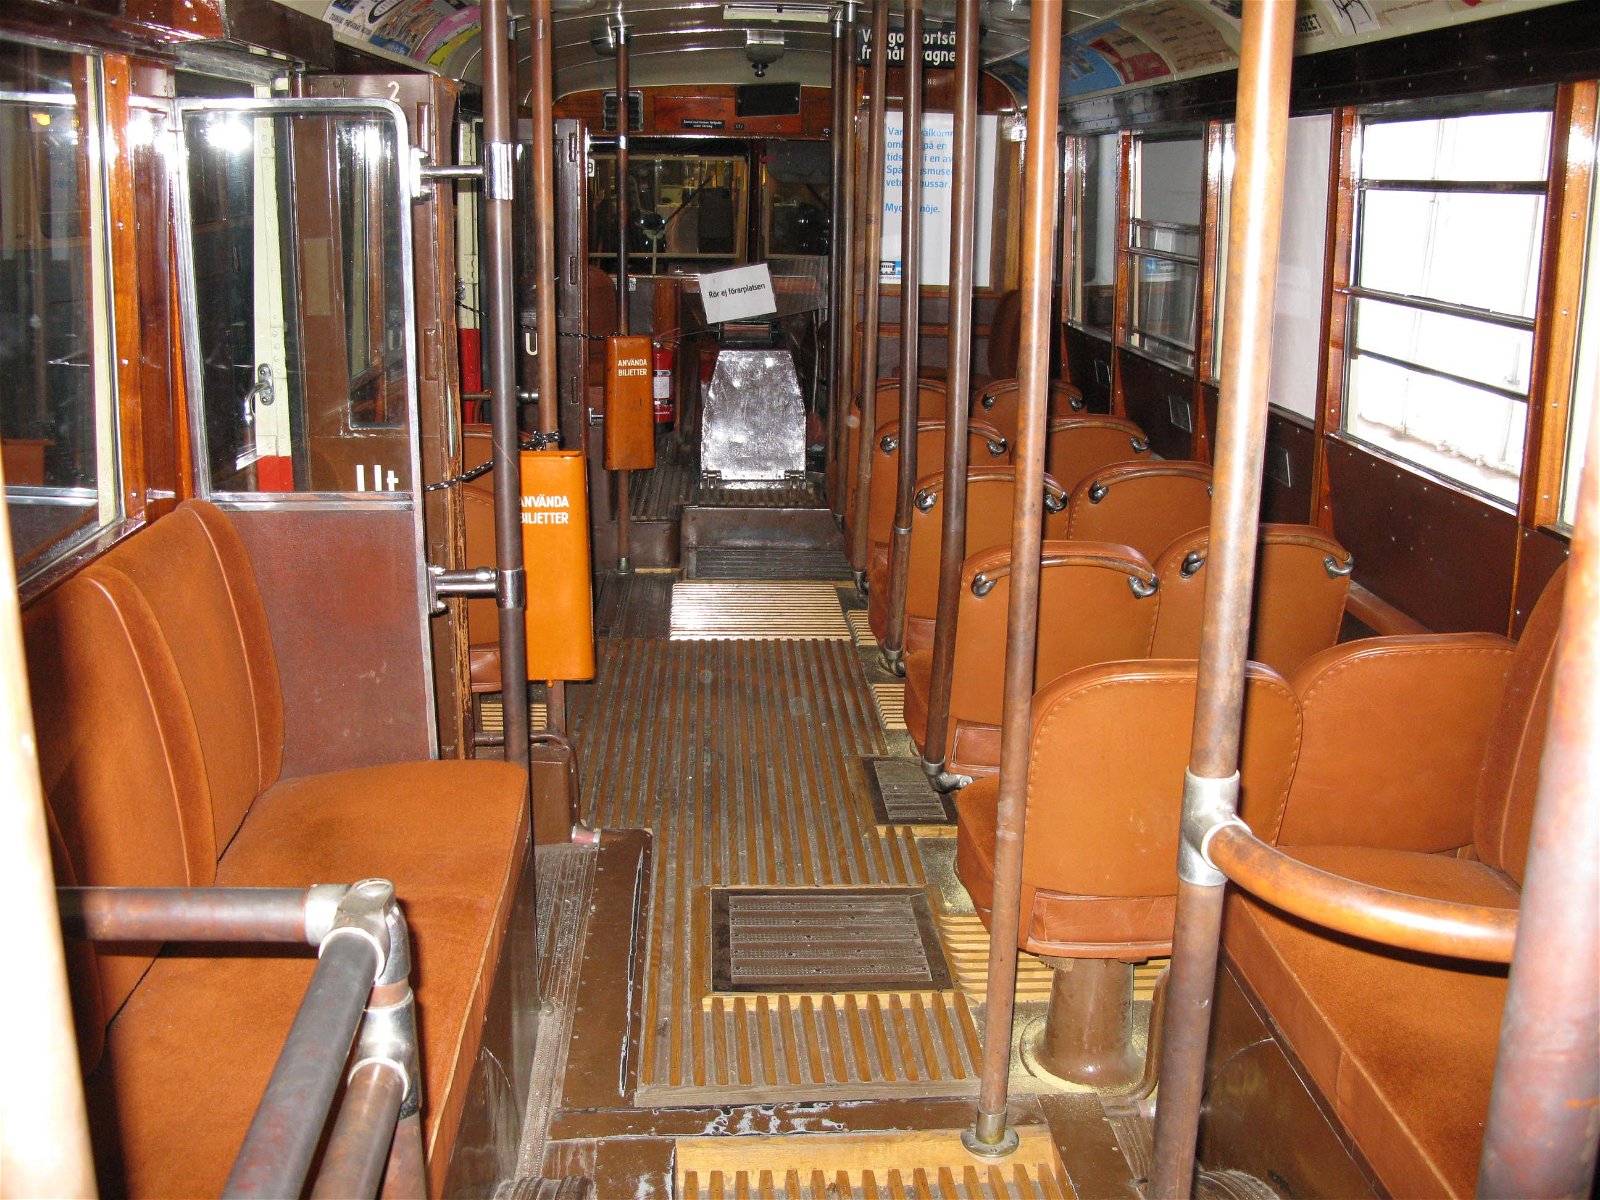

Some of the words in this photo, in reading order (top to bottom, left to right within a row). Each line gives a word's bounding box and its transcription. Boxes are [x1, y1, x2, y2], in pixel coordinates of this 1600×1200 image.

[888, 32, 905, 47] go
[922, 31, 956, 45] ortsä
[922, 50, 956, 65] agne
[387, 81, 400, 102] 2
[929, 155, 940, 163] en
[708, 289, 719, 299] Rör
[721, 289, 728, 299] ej
[728, 282, 766, 296] förarplatsen
[617, 358, 648, 367] ANVÄNDA
[618, 368, 648, 377] BILJETTER
